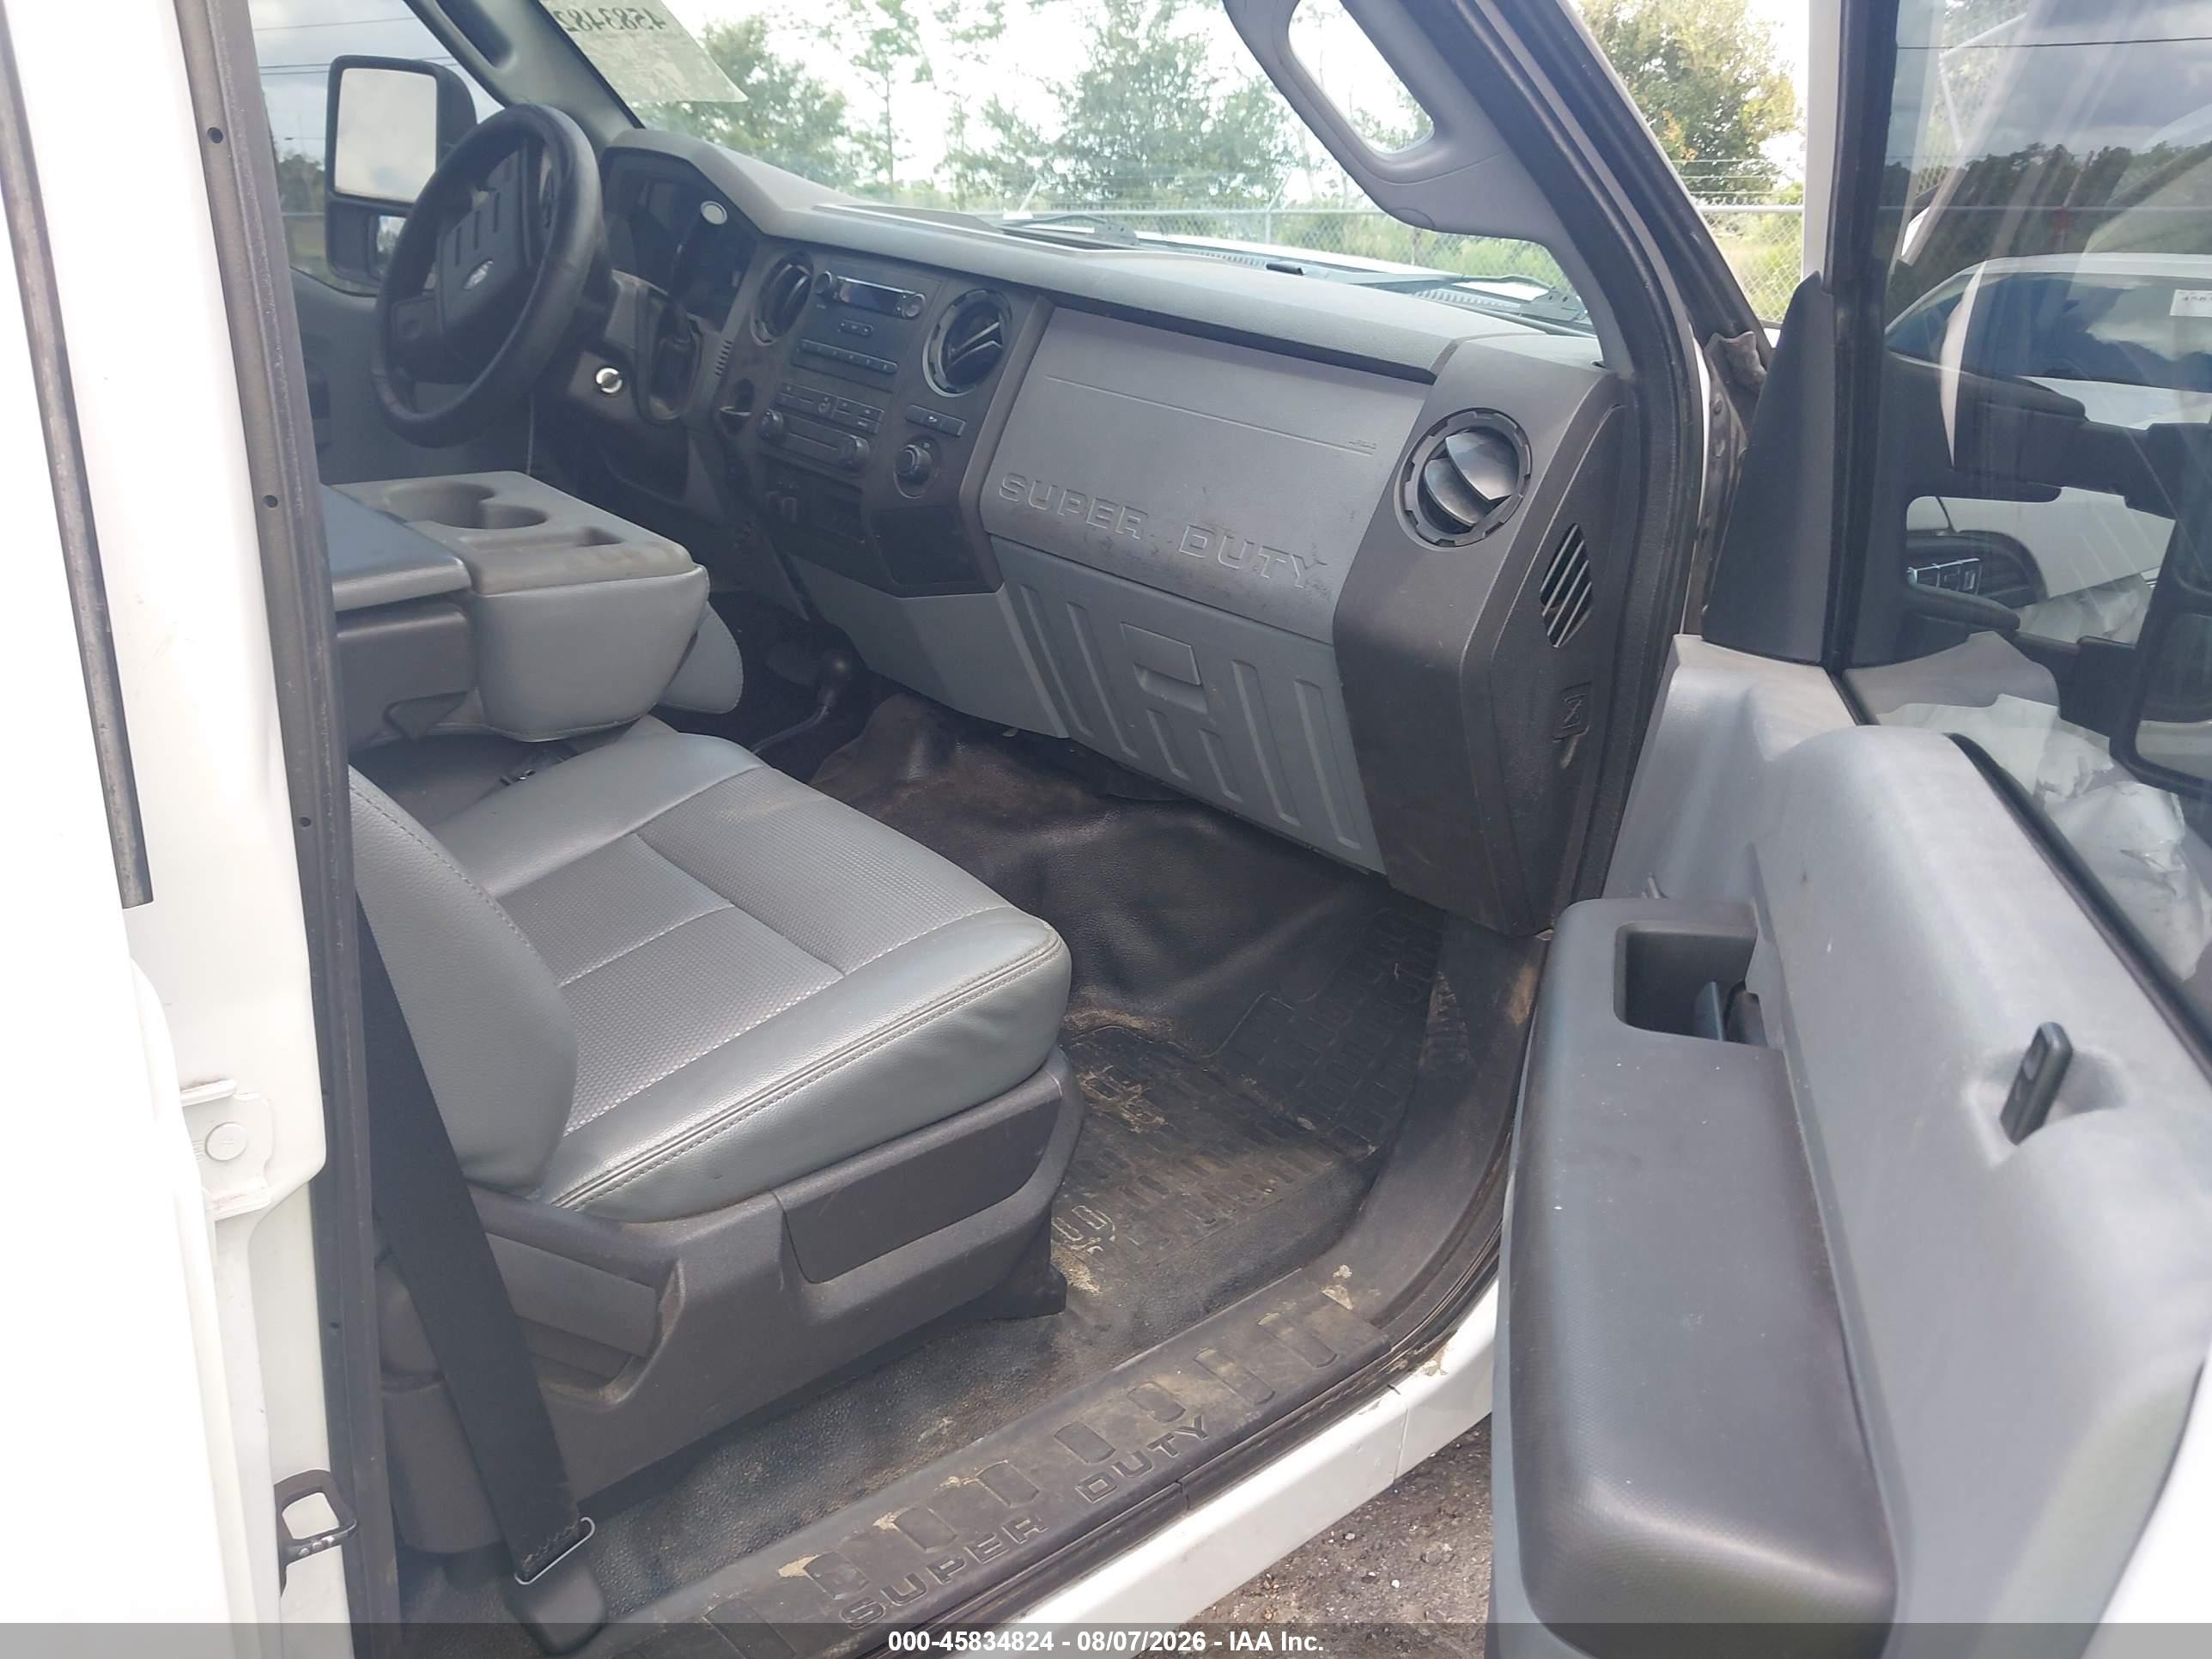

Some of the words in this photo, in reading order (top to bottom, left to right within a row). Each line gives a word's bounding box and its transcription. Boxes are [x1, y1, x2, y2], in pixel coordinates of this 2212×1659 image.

[999, 471, 1148, 540] SUPER
[1178, 523, 1328, 589] DUTY
[839, 1514, 1049, 1629] SUPER
[1074, 1414, 1209, 1504] DUTY
